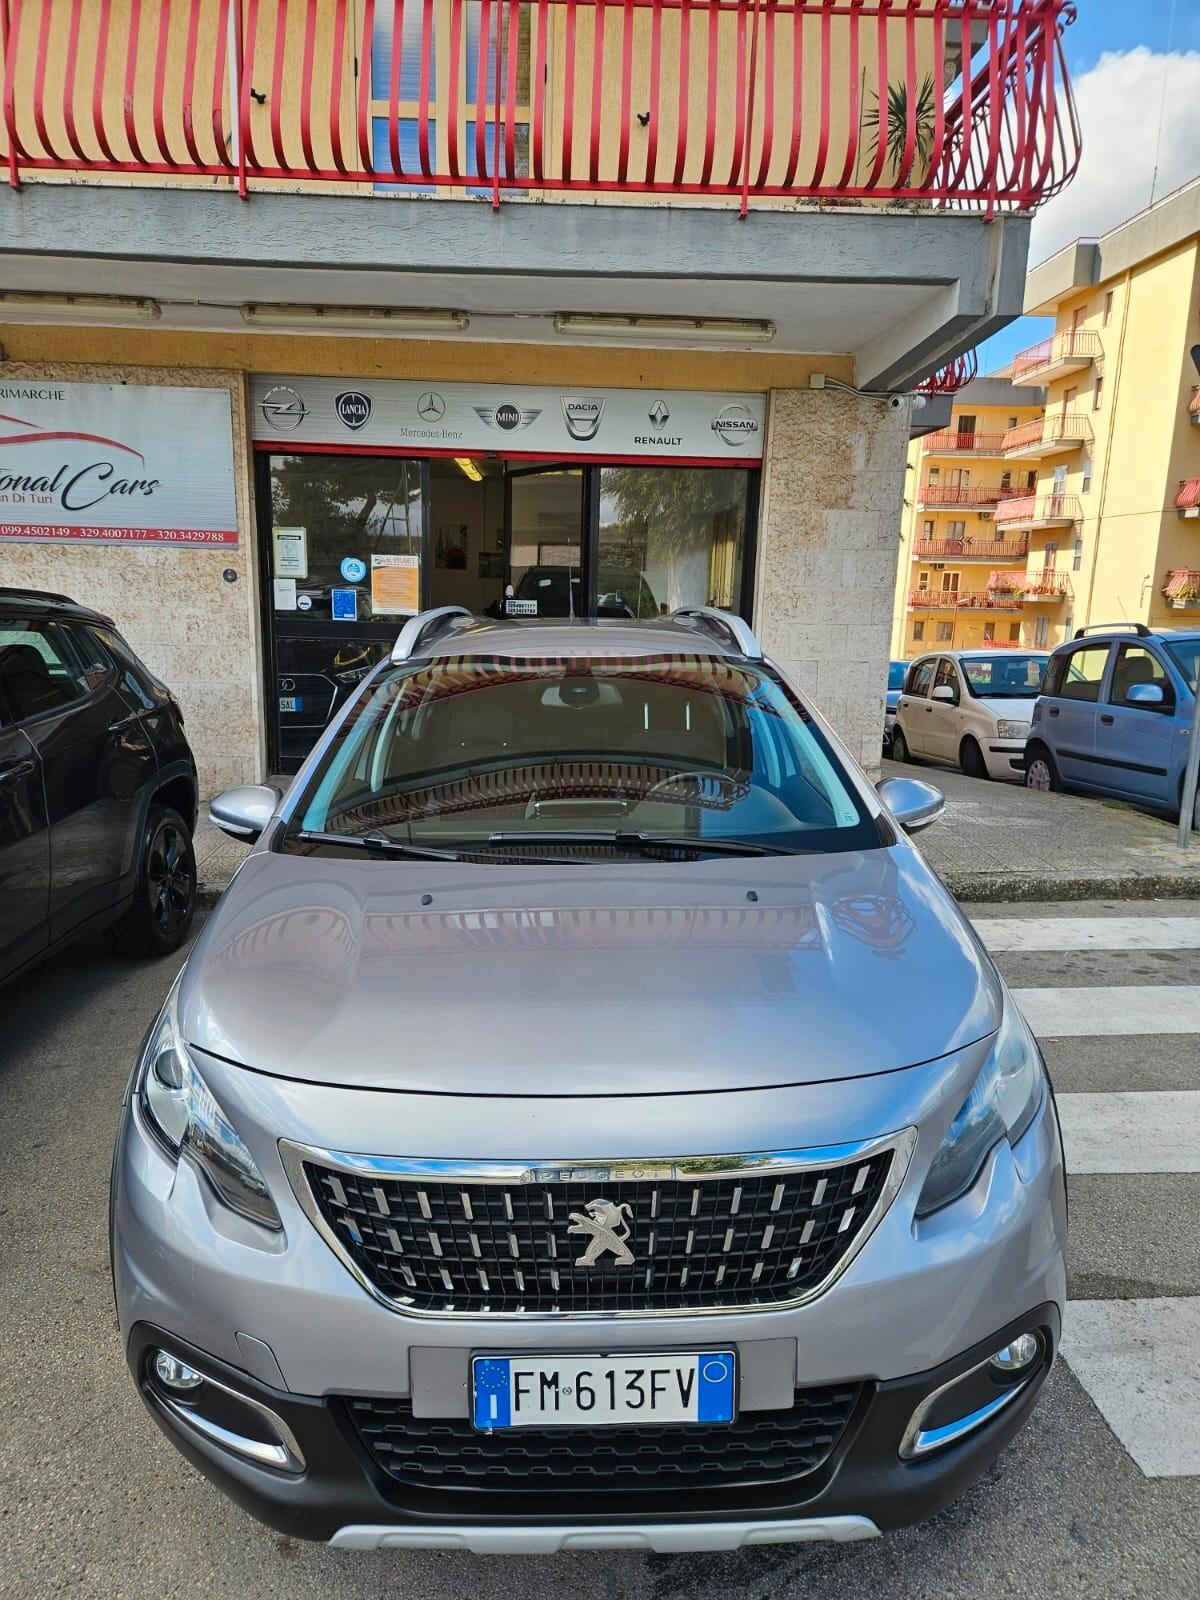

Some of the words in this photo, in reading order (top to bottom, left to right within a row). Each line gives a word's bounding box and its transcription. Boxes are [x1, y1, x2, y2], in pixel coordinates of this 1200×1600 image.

[342, 403, 366, 415] LANCIA
[568, 403, 598, 412] DACIA
[496, 412, 518, 423] MINI
[715, 420, 754, 430] NISSAN
[400, 428, 463, 439] Mercedes-Benz
[634, 436, 683, 446] RENAULT
[0, 464, 69, 492] onal
[61, 462, 162, 511] Cars
[12, 493, 25, 503] Di
[29, 493, 53, 504] Turi
[1, 525, 70, 537] 099.4502149
[80, 528, 147, 539] 329.4007177
[157, 530, 224, 542] 320.3429788
[540, 1168, 662, 1182] PEUGEOT
[514, 1371, 560, 1412] FM
[575, 1367, 695, 1411] 613FV
